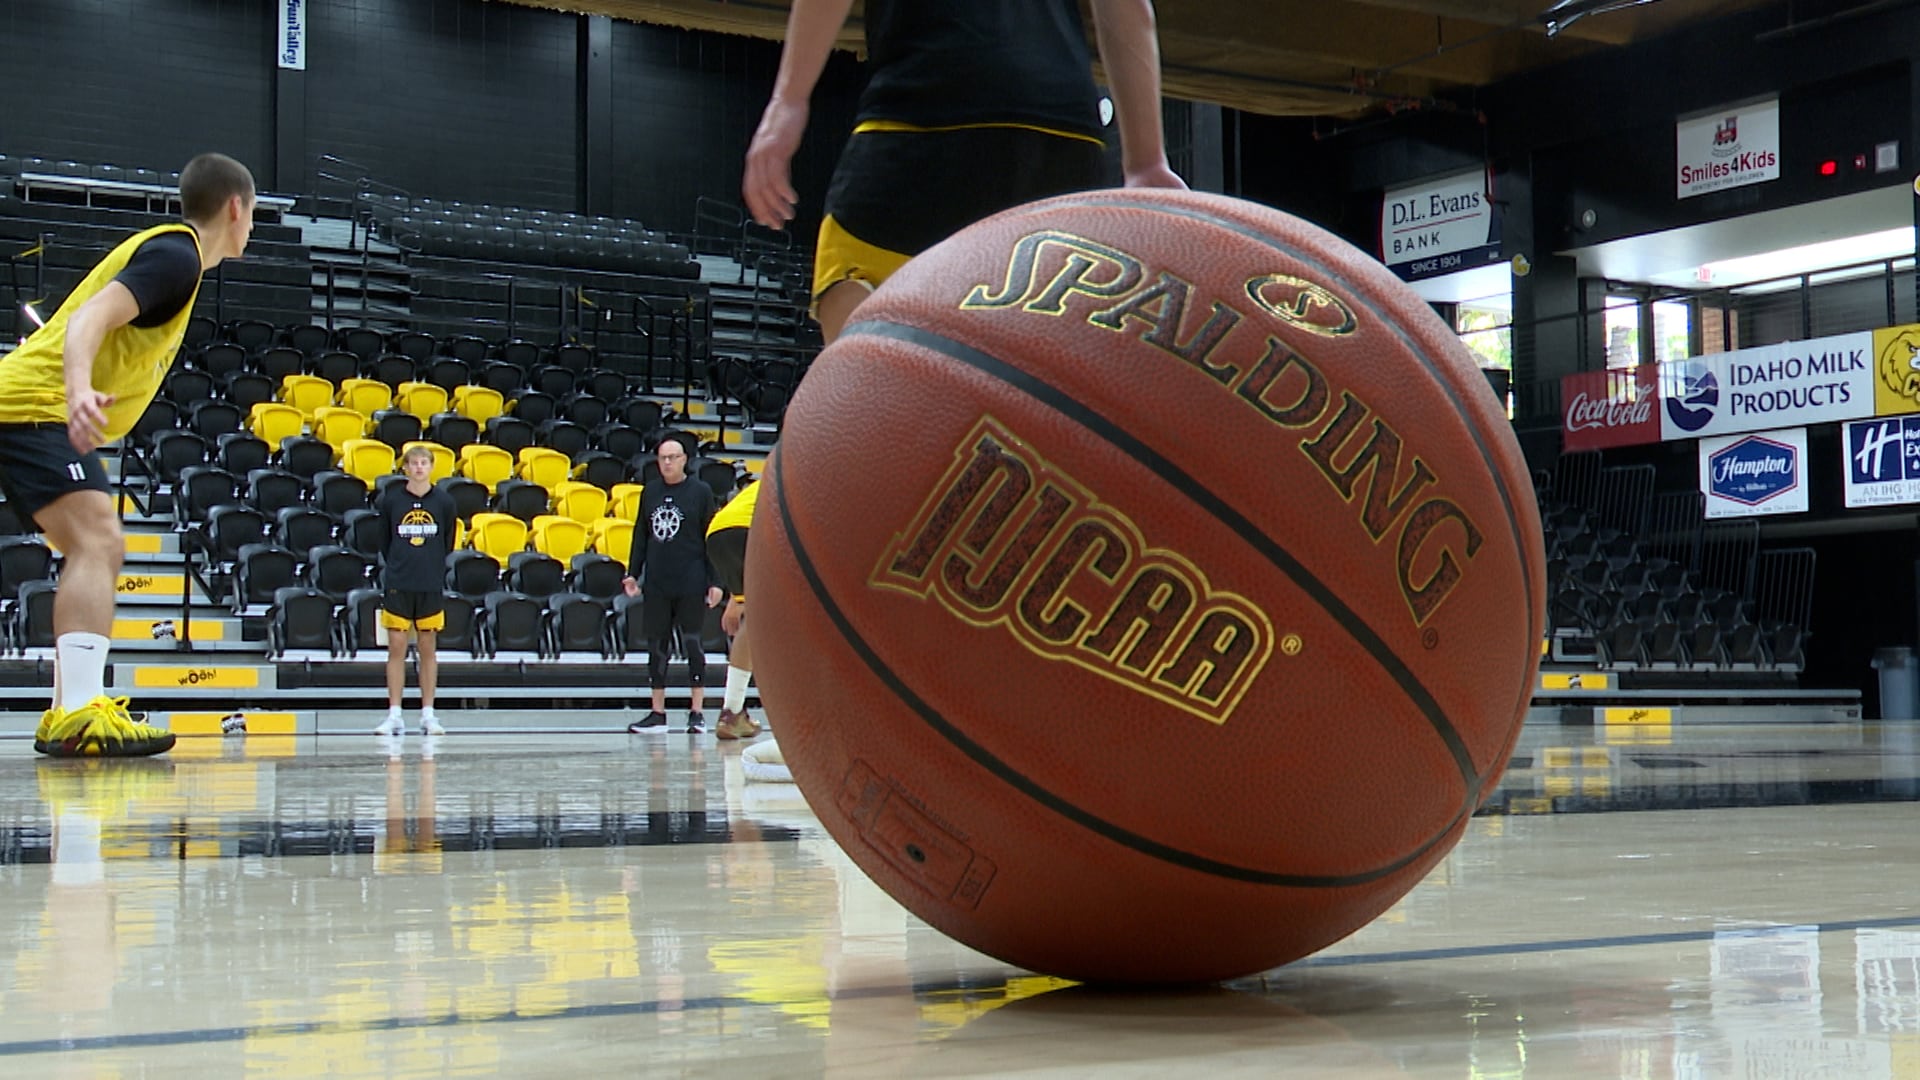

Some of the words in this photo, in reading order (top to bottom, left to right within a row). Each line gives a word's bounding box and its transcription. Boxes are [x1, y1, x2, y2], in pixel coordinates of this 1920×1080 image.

[1680, 150, 1776, 184] Smiles4Kids
[1392, 199, 1426, 226] D.L.
[1430, 191, 1480, 217] Evans
[1393, 231, 1441, 254] BANK
[1411, 258, 1439, 274] SINCE
[1730, 358, 1803, 386] IDAHO
[1807, 349, 1865, 376] MILK
[1731, 381, 1851, 417] PRODUCTS
[961, 231, 1483, 629] SPALDING
[67, 456, 86, 482] 11
[1712, 455, 1793, 484] Hampton
